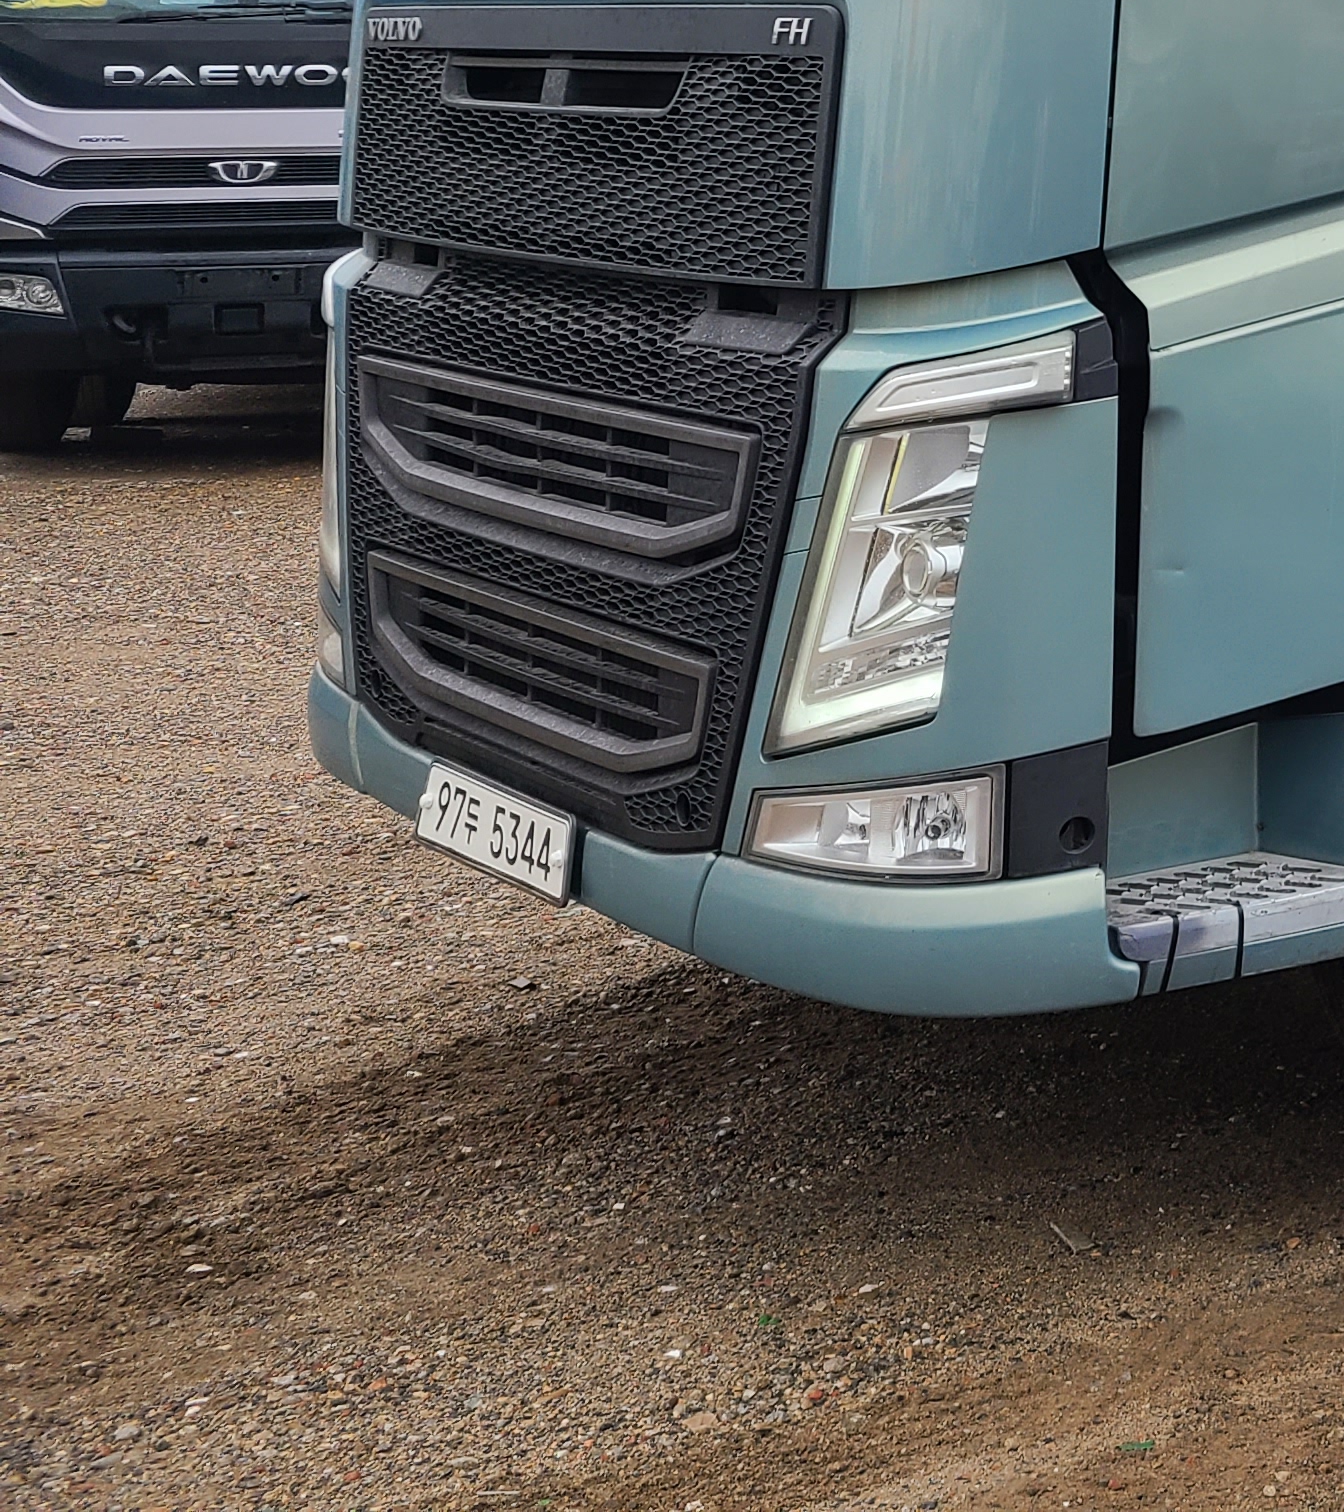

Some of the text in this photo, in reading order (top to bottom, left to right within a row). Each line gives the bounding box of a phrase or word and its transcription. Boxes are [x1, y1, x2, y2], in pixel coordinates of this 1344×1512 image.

[367, 16, 424, 42] VOLVO
[771, 17, 814, 46] FH
[103, 64, 351, 88] DAEWO
[435, 780, 552, 882] 97두 5344
